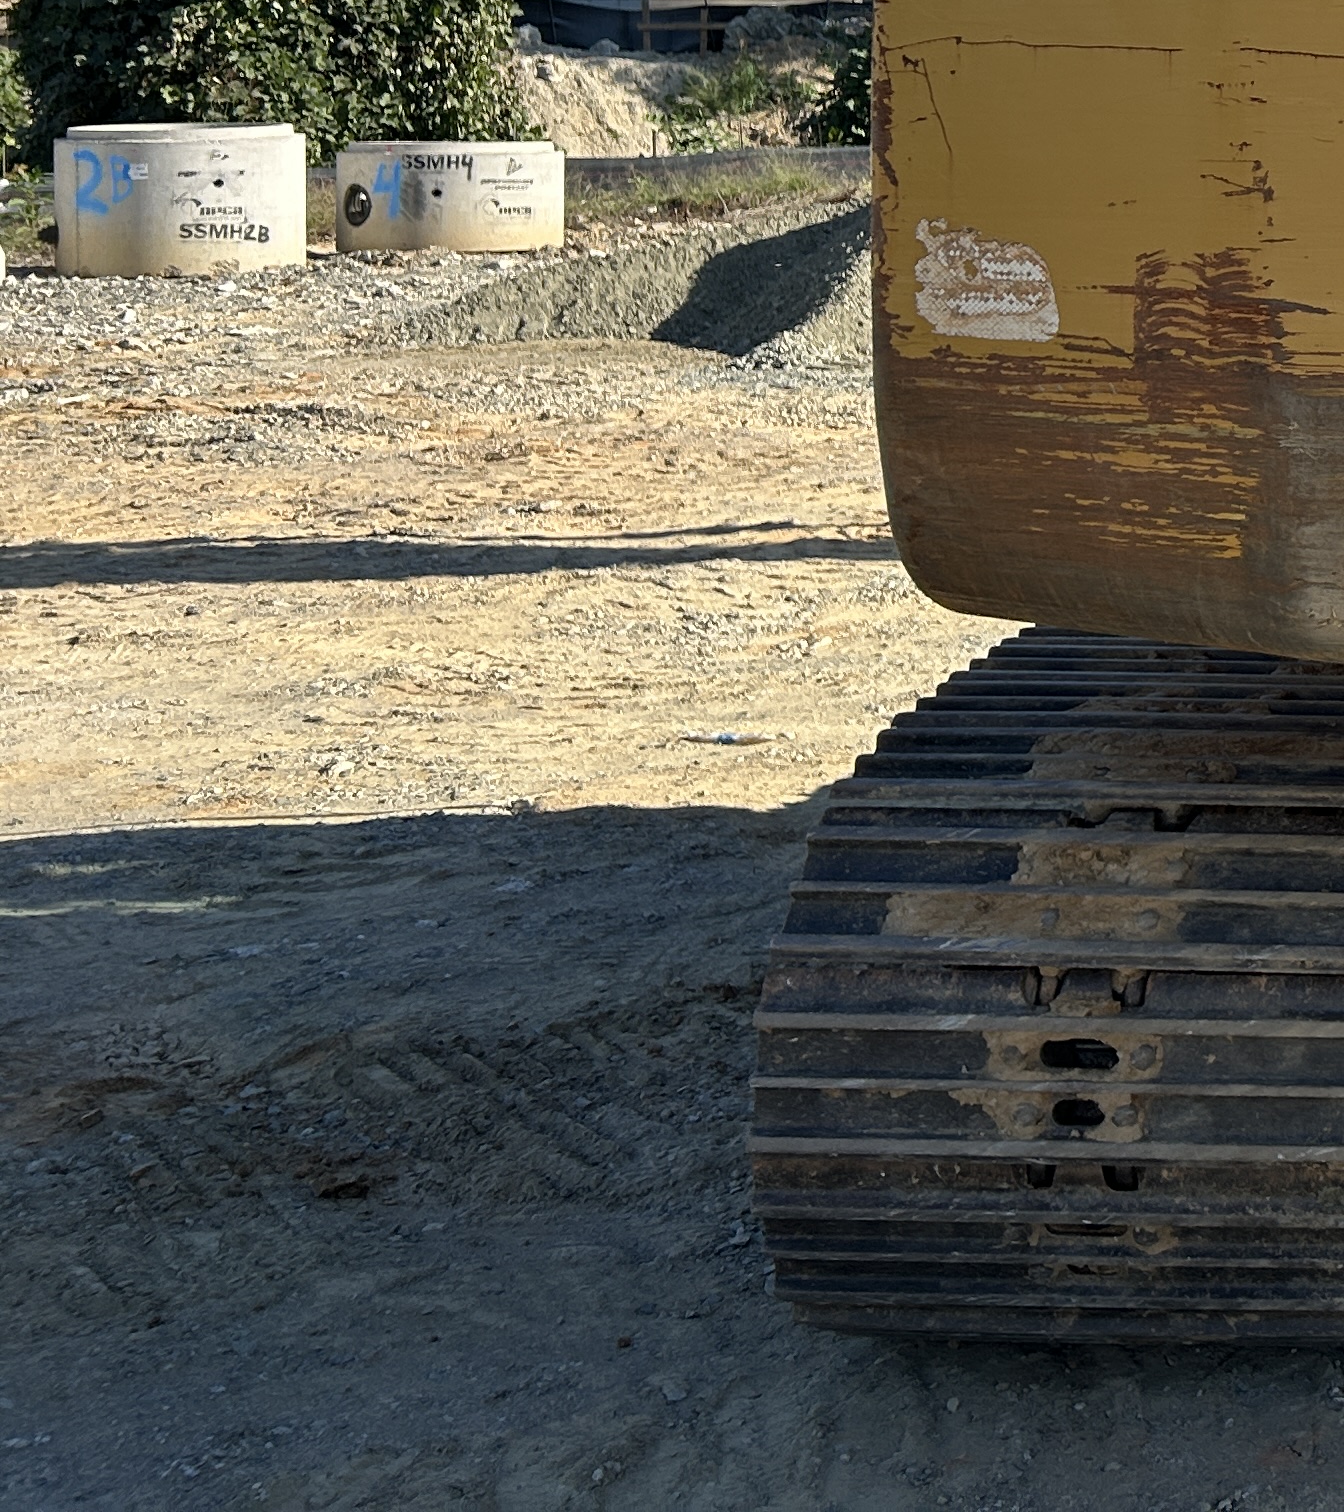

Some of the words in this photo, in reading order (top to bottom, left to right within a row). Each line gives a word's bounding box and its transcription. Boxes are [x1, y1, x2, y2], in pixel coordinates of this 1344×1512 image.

[73, 148, 134, 215] 2B
[372, 157, 401, 221] 4
[179, 223, 270, 243] SSMH2B
